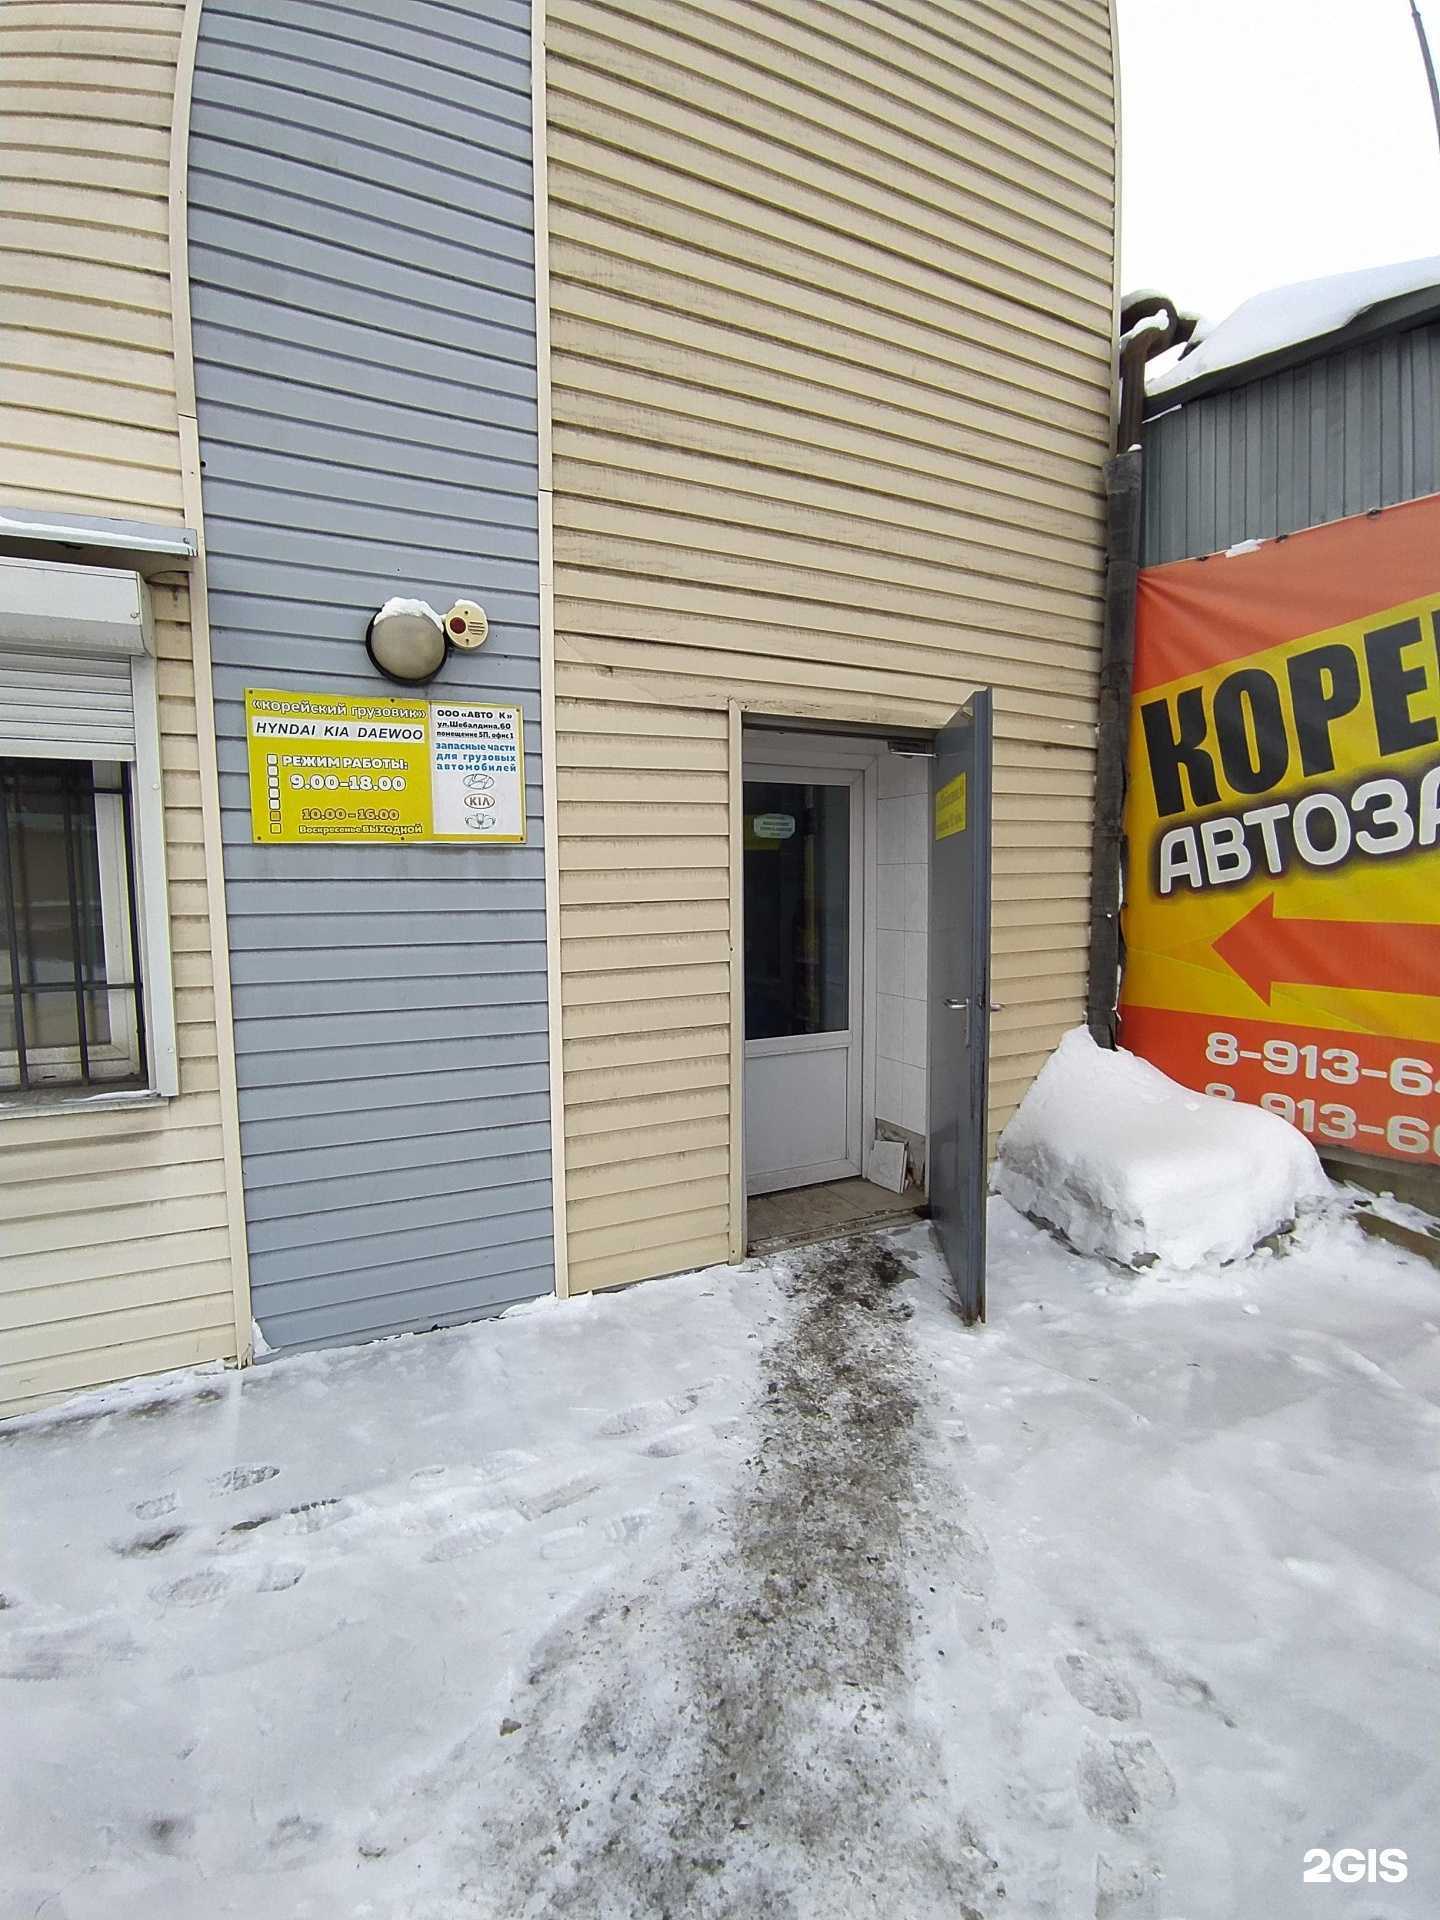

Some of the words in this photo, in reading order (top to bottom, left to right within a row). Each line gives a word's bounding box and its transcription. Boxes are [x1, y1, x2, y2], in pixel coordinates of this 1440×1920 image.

[252, 698, 347, 715] «корейский
[351, 706, 427, 720] грузовик»
[437, 710, 459, 718] ООО
[1141, 609, 1440, 817] КОРЕ
[255, 721, 316, 736] HYNDAI
[323, 725, 350, 737] KIA
[357, 727, 423, 741] DAEWOO
[436, 742, 486, 750] запасные
[281, 754, 341, 768] РЕЖИМ
[342, 757, 409, 771] РАБОТЫ:
[436, 753, 458, 761] для
[463, 754, 516, 763] грузовых
[436, 762, 516, 772] автомобилей
[470, 796, 491, 806] KIA
[302, 808, 346, 820] 10.00
[357, 809, 400, 820] 16.00
[299, 825, 362, 835] Воскресенье
[362, 823, 423, 835] ВЫХОДНОЙ
[1205, 1031, 1440, 1097] 8-913-6
